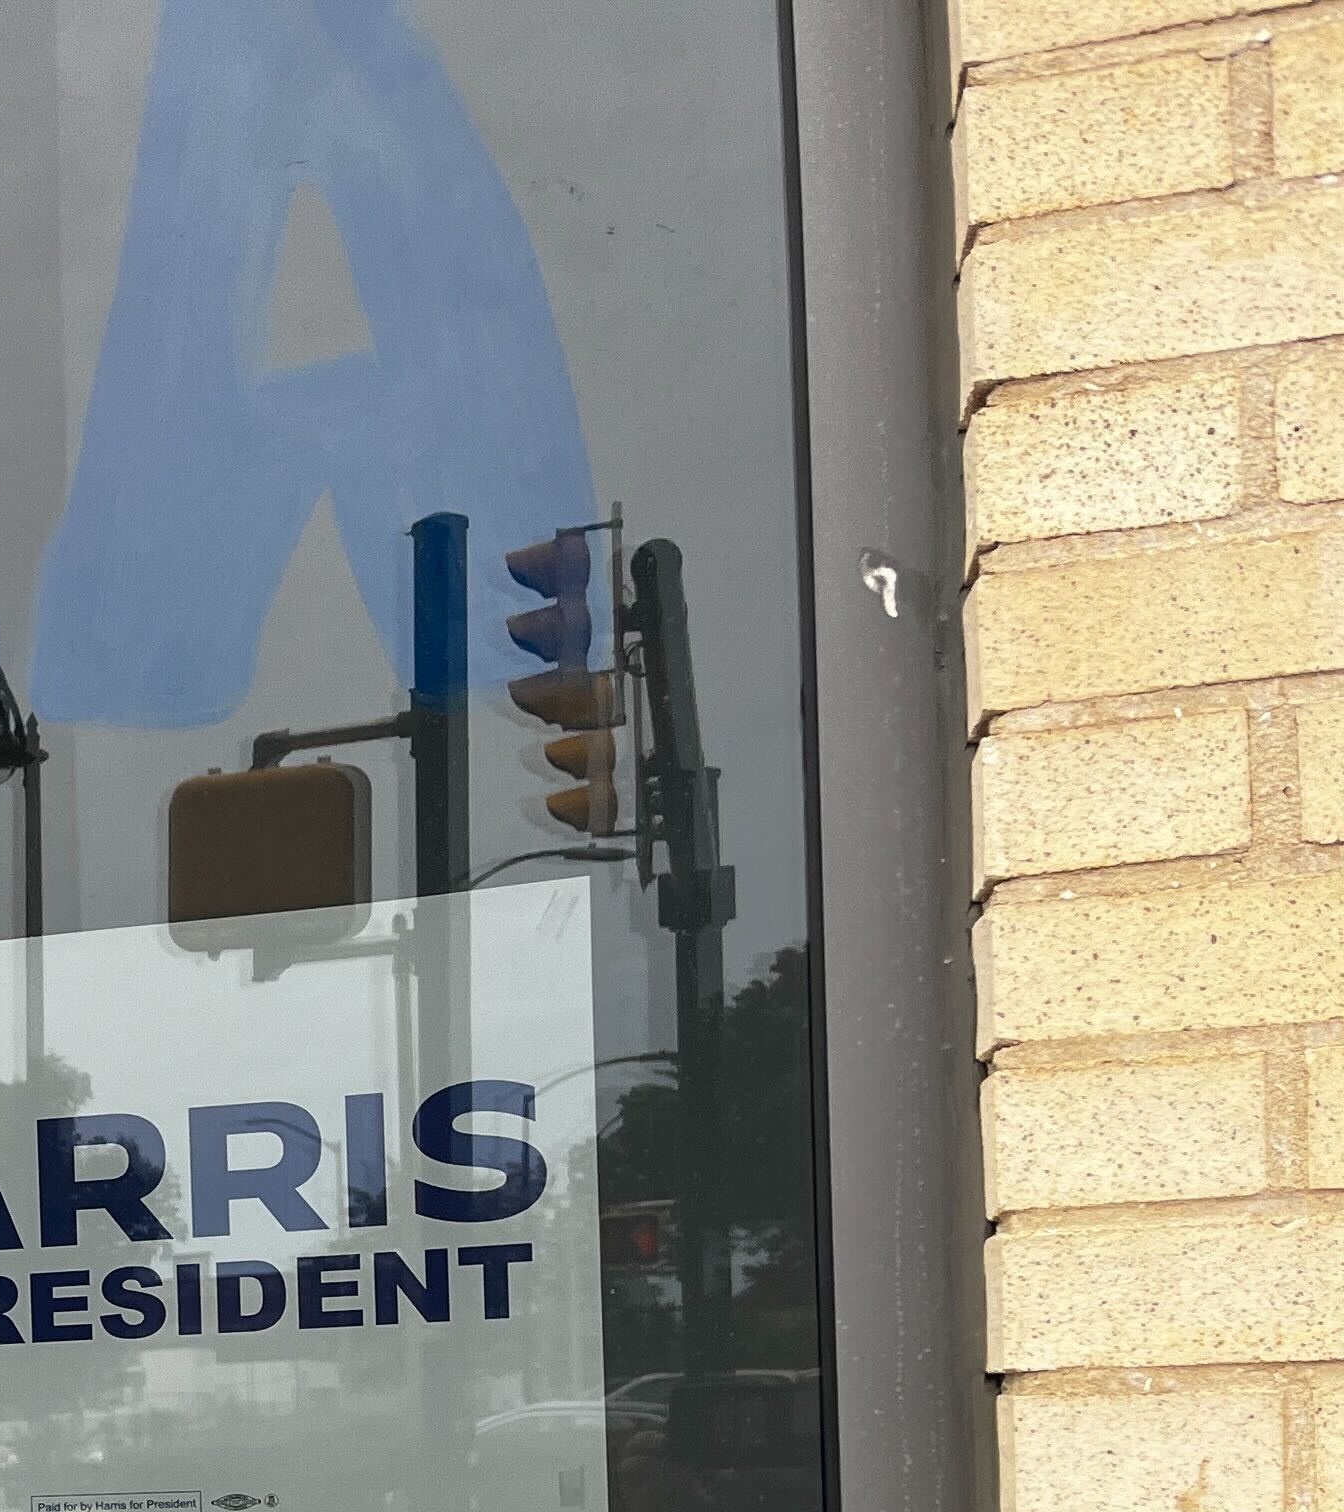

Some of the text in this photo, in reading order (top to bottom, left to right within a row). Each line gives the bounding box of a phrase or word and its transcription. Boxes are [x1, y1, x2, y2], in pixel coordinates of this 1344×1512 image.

[37, 1498, 197, 1512] Paid for by Harris for President
